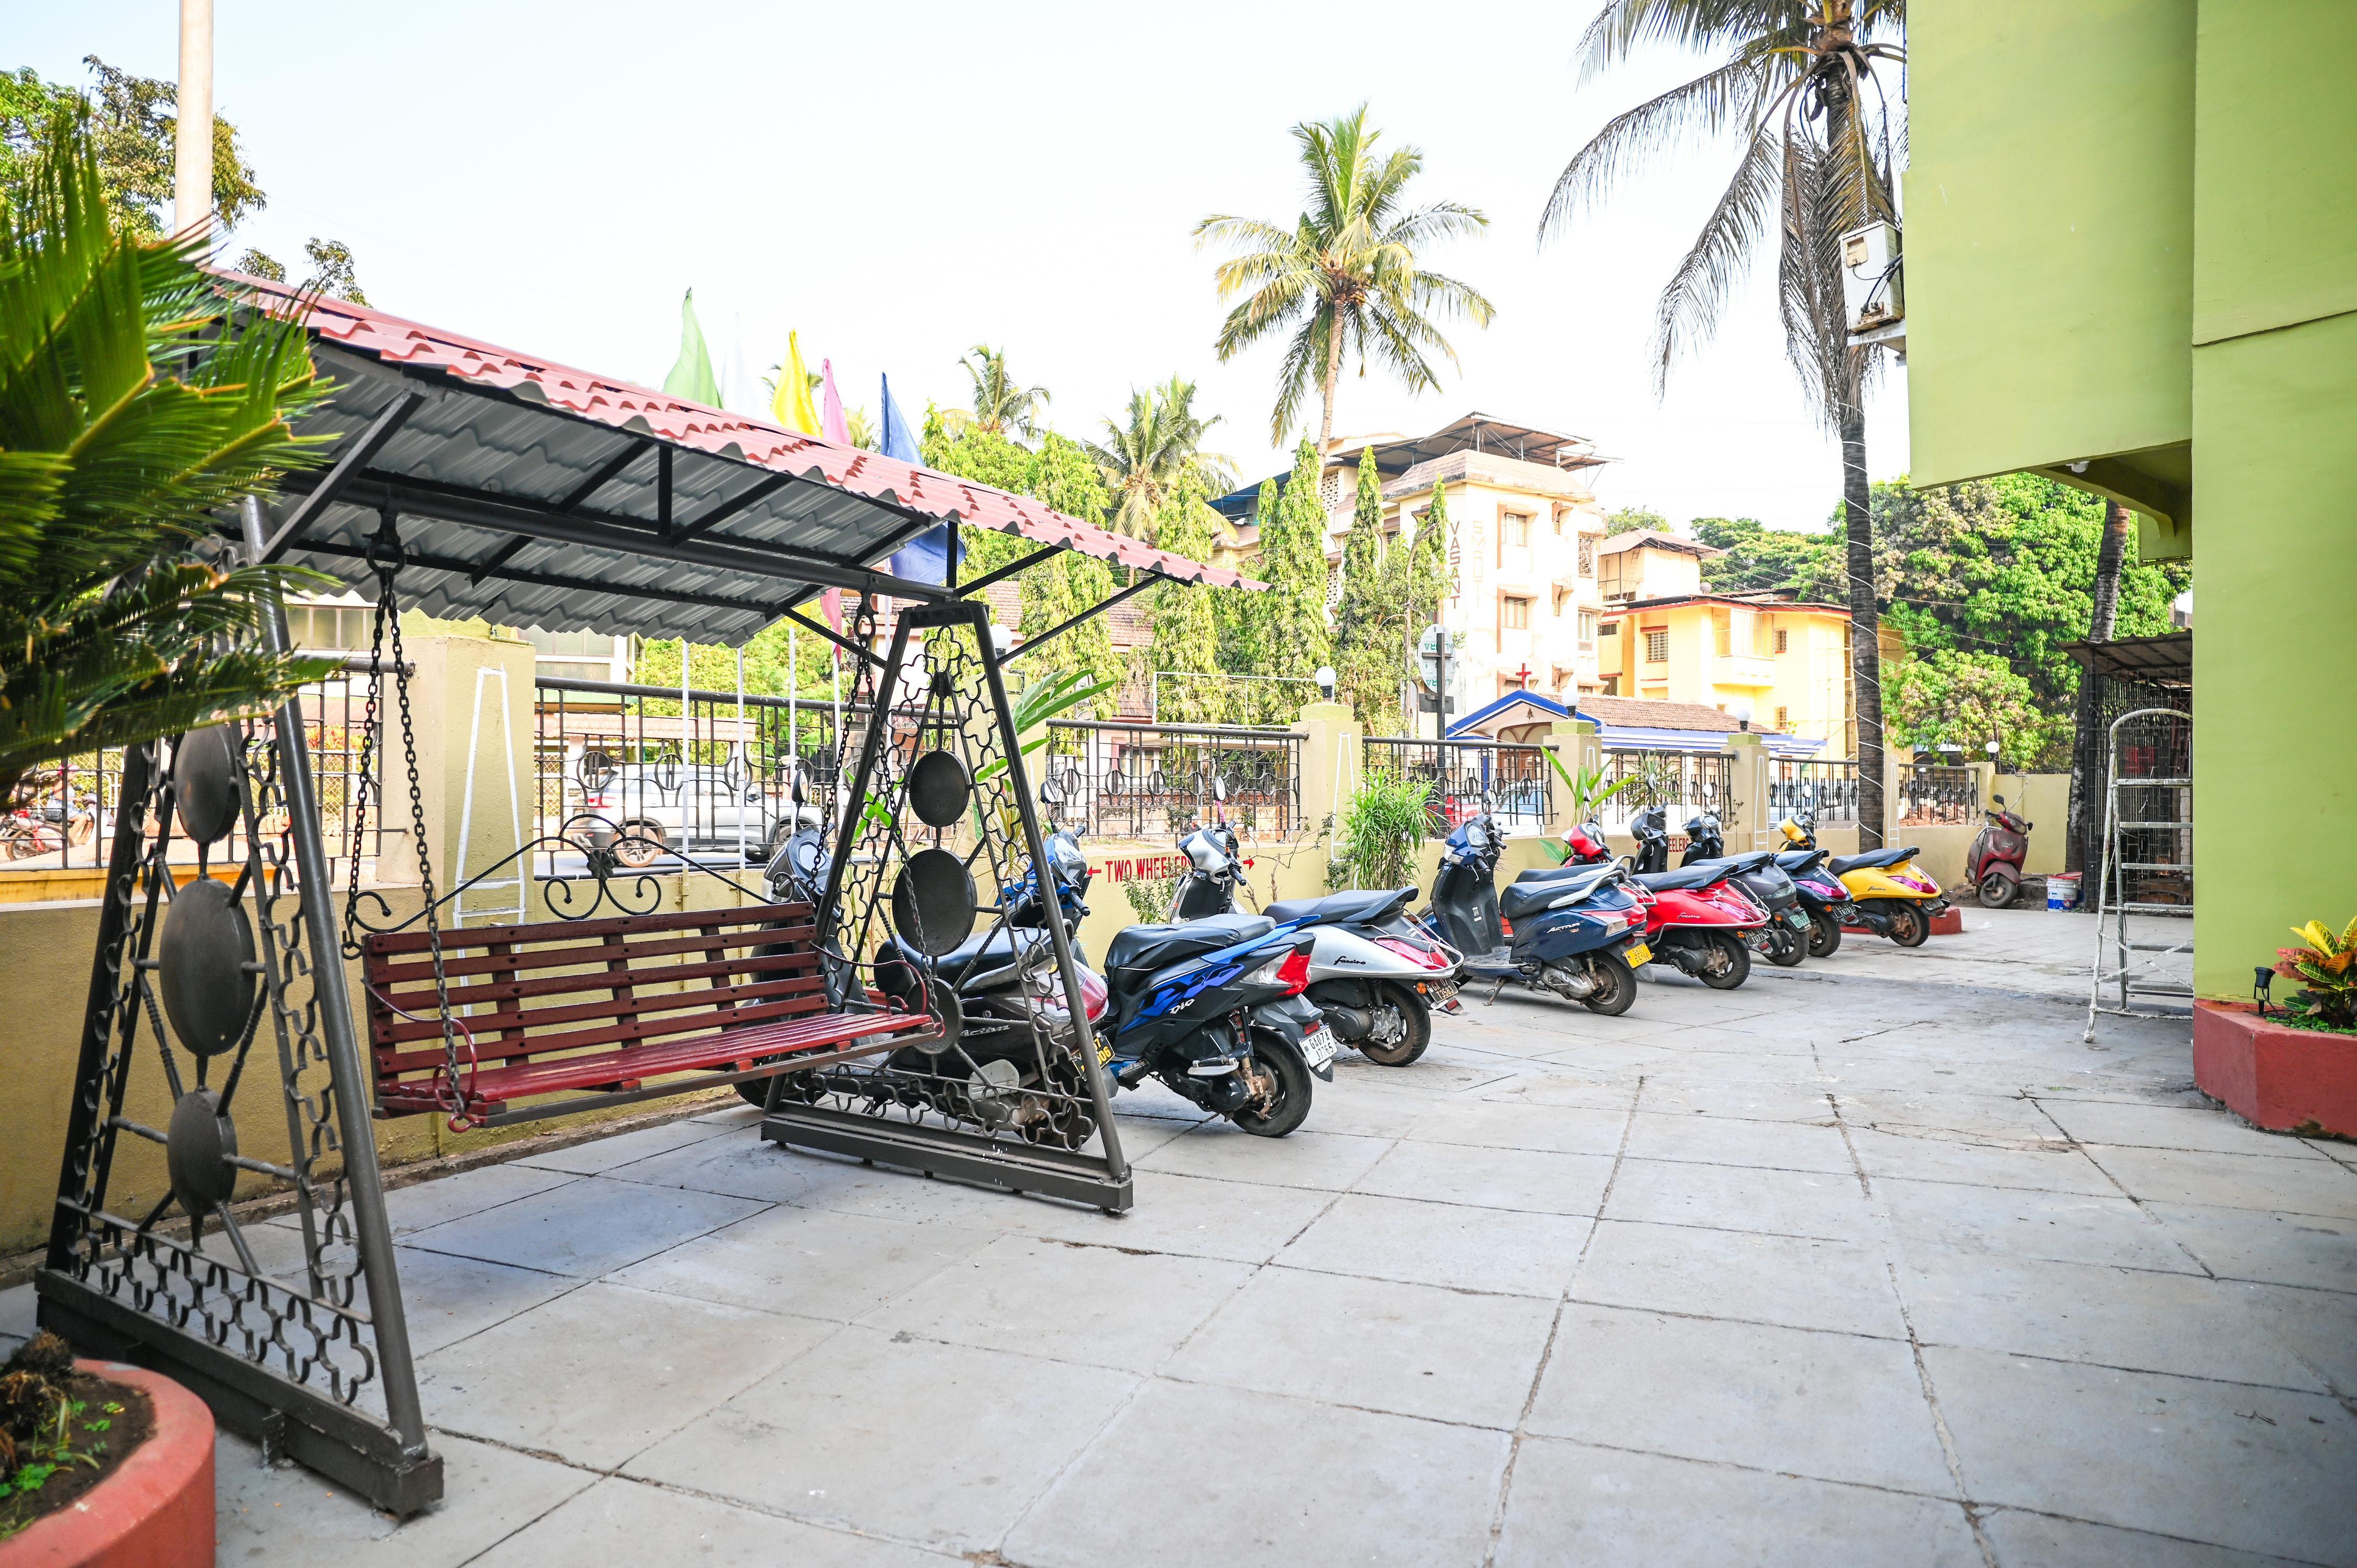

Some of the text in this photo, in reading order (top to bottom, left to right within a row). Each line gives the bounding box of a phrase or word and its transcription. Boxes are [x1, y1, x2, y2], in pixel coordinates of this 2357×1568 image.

[1449, 521, 1460, 609] VASANT
[1105, 859, 1132, 882] TWO
[1436, 985, 1454, 999] T3583
[1316, 1043, 1334, 1061] J7765
